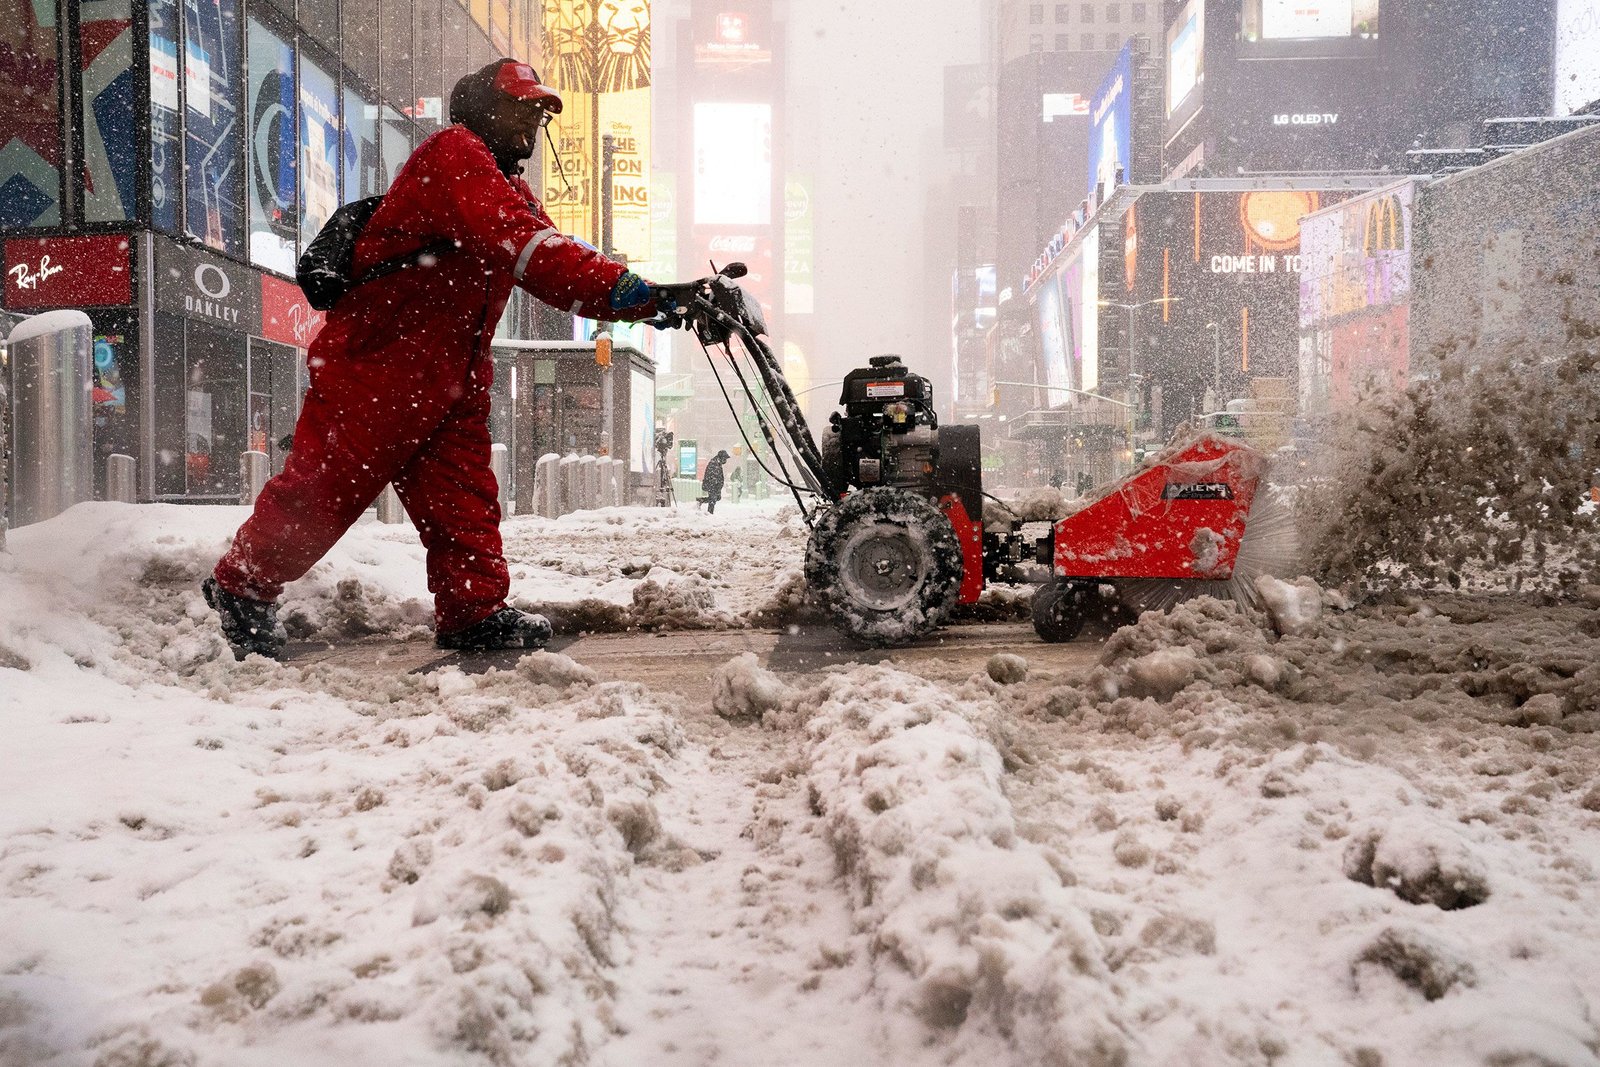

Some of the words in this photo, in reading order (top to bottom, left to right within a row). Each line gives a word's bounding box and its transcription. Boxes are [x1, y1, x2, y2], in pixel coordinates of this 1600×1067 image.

[1273, 114, 1288, 124] LG
[1291, 114, 1321, 124] OLED
[1322, 113, 1339, 124] TV
[612, 137, 636, 151] HE
[612, 159, 642, 173] ION
[613, 185, 648, 202] ING
[1211, 255, 1255, 273] COME
[1258, 255, 1275, 273] IN
[185, 295, 239, 323] OAKLEY
